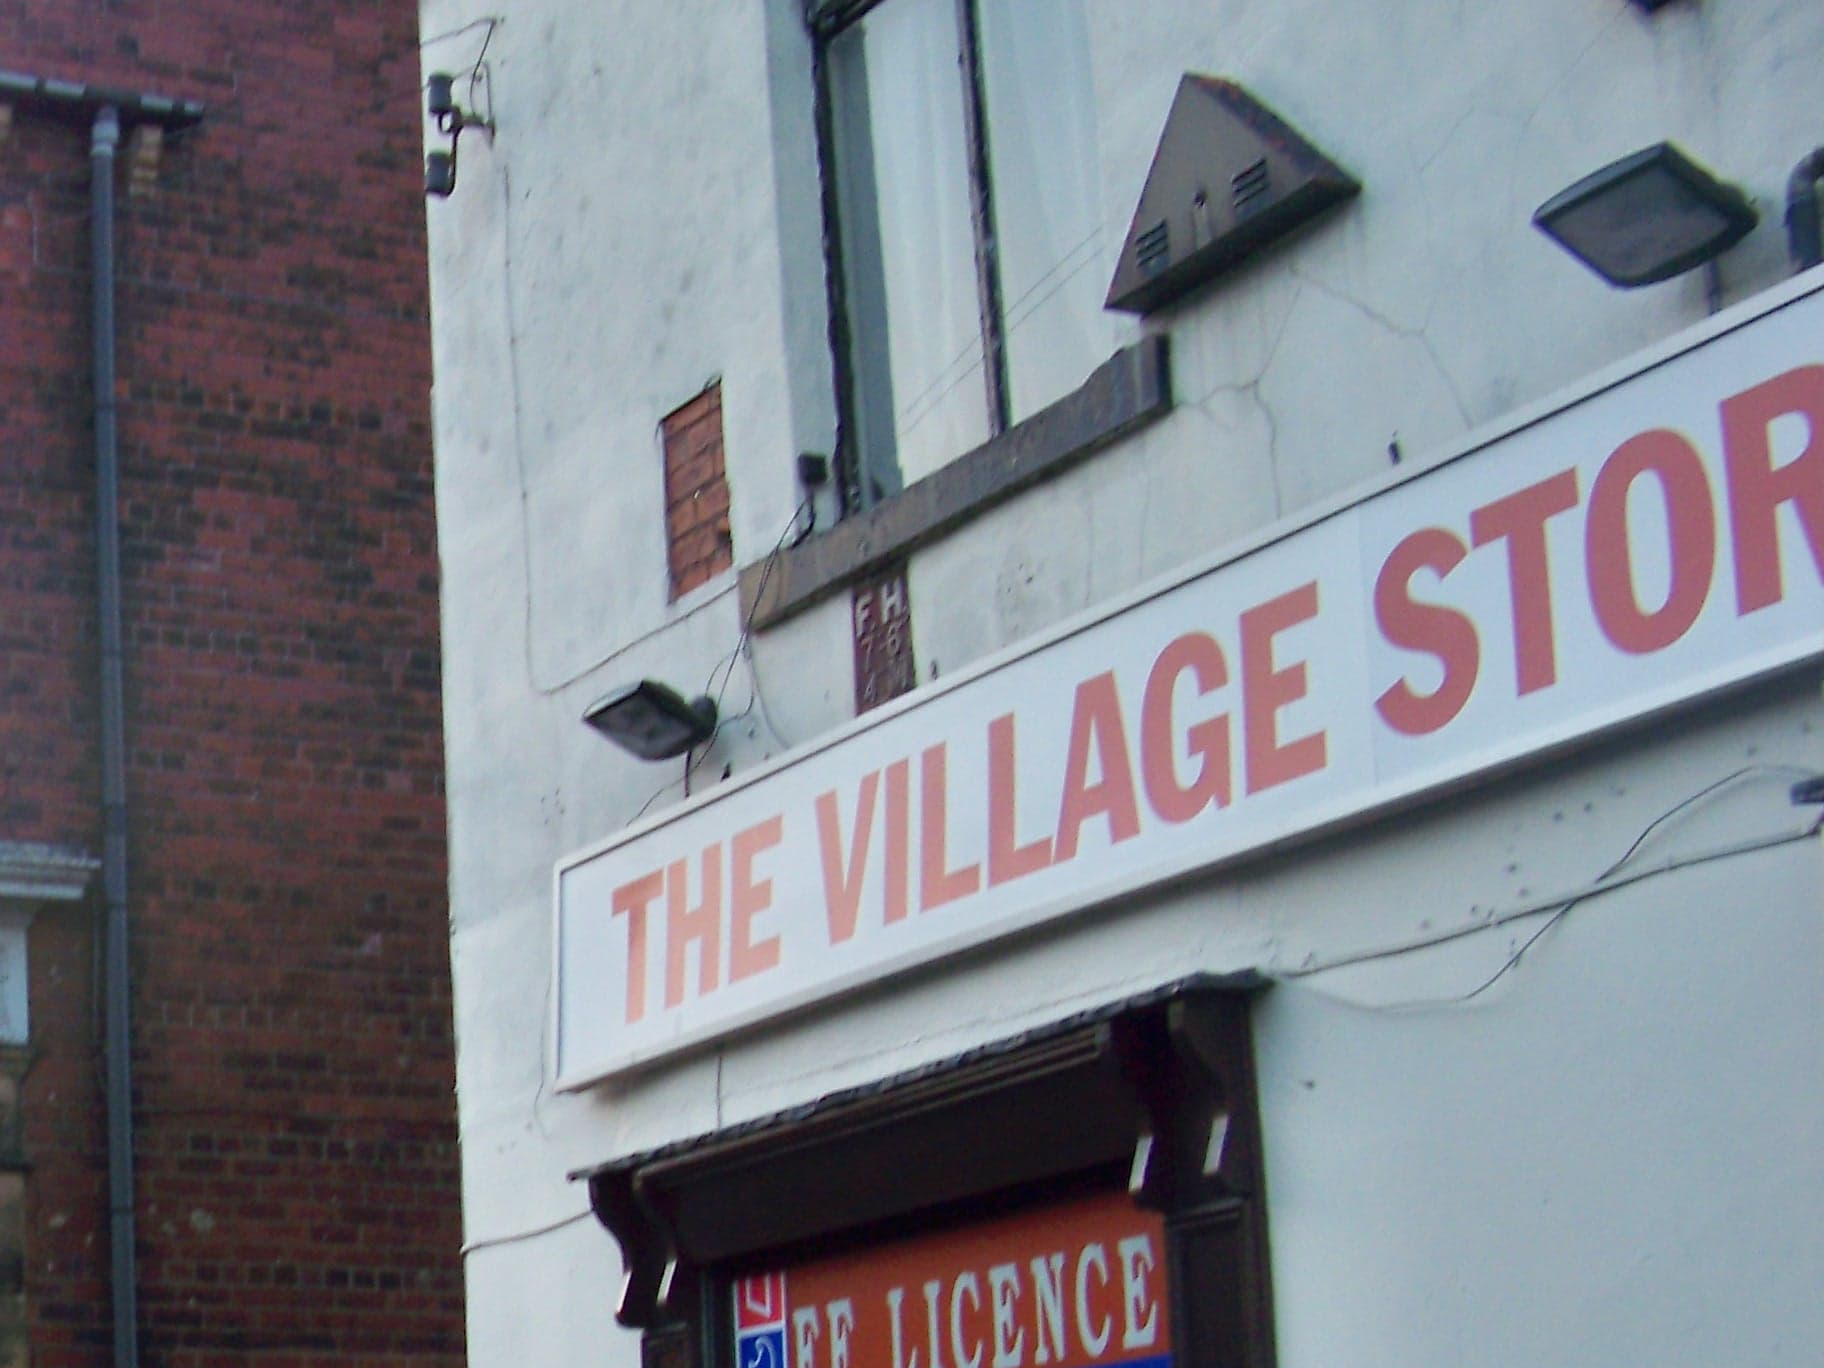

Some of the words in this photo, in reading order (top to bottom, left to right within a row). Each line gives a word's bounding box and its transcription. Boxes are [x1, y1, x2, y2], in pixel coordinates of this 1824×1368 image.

[610, 812, 784, 1026] THE
[814, 579, 1328, 947] VILLAGE
[1373, 362, 1824, 738] STOR
